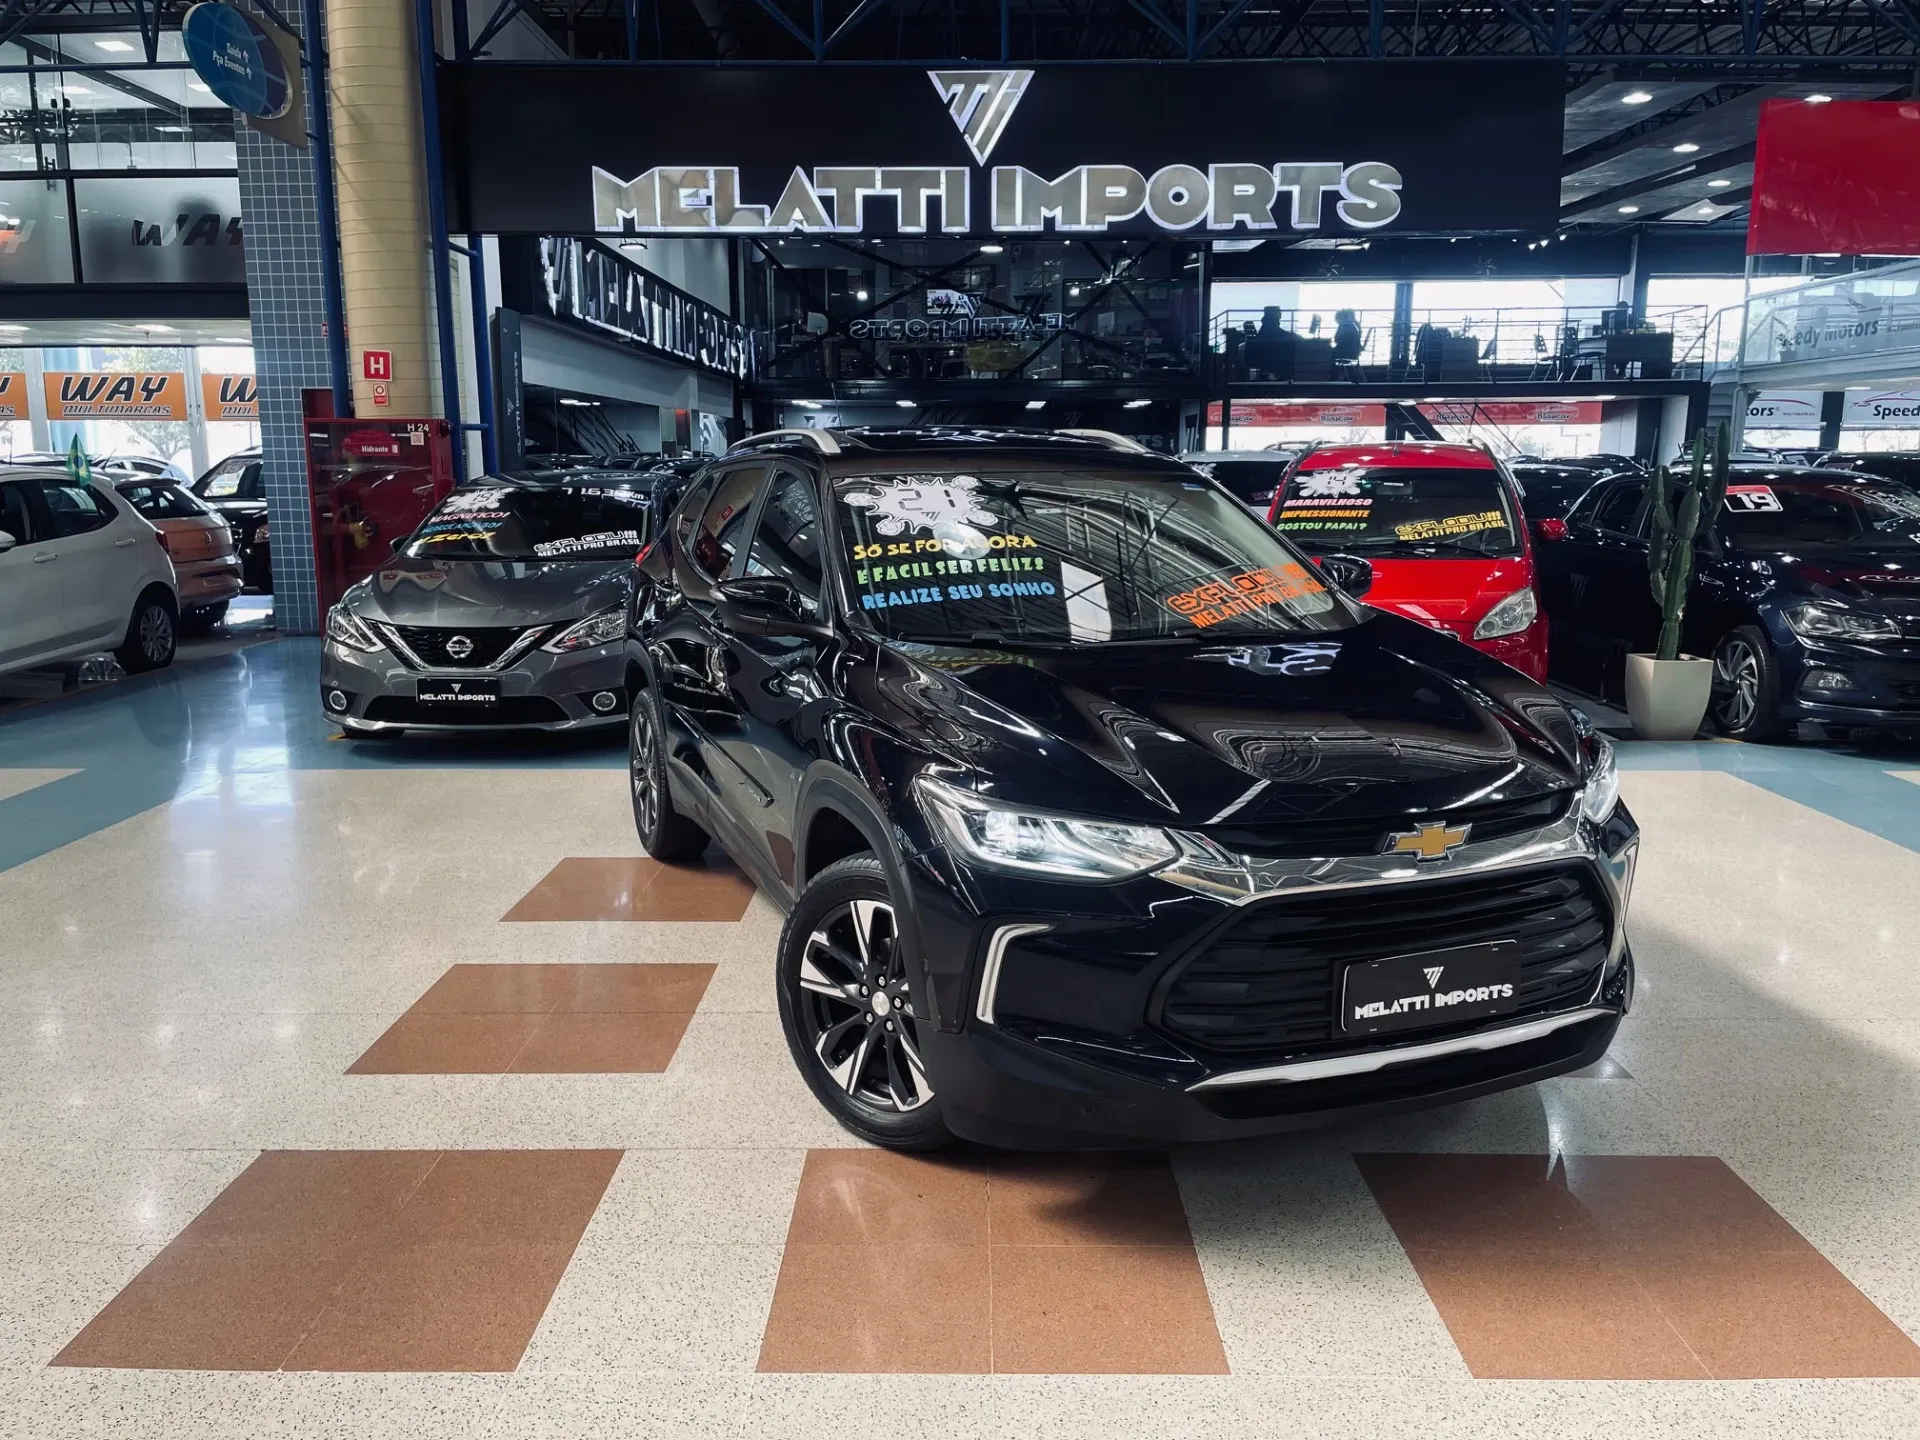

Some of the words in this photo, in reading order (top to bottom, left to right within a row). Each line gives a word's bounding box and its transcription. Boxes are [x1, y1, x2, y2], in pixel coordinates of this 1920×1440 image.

[224, 56, 245, 75] Eventos
[591, 165, 971, 232] MELATTI
[991, 161, 1403, 232] IMPORTS
[370, 356, 384, 375] H
[60, 376, 169, 403] WAY
[64, 405, 172, 414] MULTIMARCAS
[417, 424, 429, 432] 24
[362, 445, 388, 453] Hidrante
[1283, 499, 1373, 507] MARAVILHOSO
[1736, 493, 1779, 510] 19
[1279, 510, 1371, 519] IMPRESSIONANTE
[1276, 522, 1322, 530] GOSTOU
[1399, 529, 1444, 541] MELATTI
[1445, 524, 1468, 535] PRO
[1469, 519, 1508, 532] BRASIL
[537, 545, 582, 557] MELATTI
[583, 541, 605, 550] PRO
[606, 538, 643, 547] BRASIL
[888, 543, 912, 556] SE
[915, 539, 954, 553] FOR
[935, 559, 973, 575] SER
[862, 587, 944, 610] REALIZE
[948, 584, 983, 600] SEU
[988, 581, 1056, 597] SONHO
[457, 694, 496, 702] IMPORTS
[1354, 994, 1430, 1020] MELATTI
[1435, 983, 1513, 1008] IMPORTS
